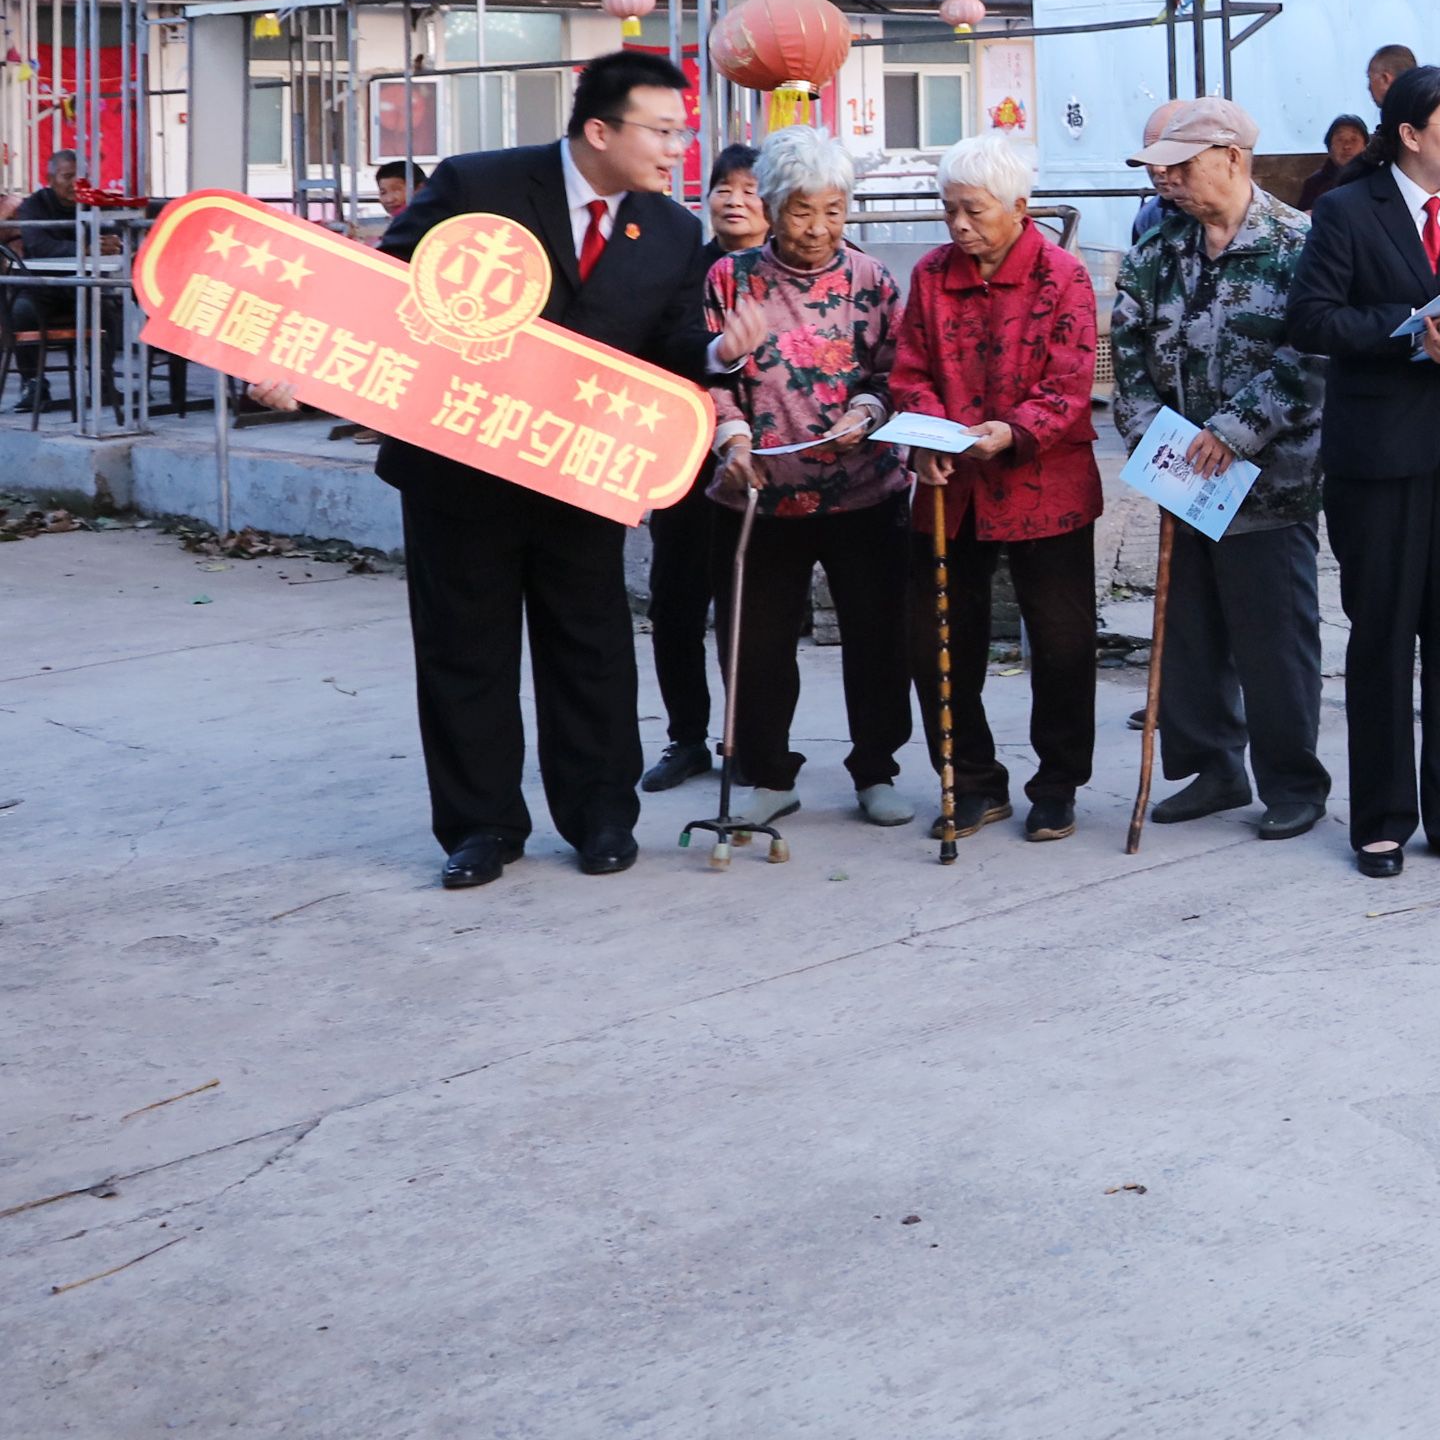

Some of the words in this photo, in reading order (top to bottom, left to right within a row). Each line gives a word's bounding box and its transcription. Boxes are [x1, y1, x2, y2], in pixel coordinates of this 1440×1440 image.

[168, 272, 420, 410] 情暖银发族
[431, 373, 659, 503] 法护夕阳红
